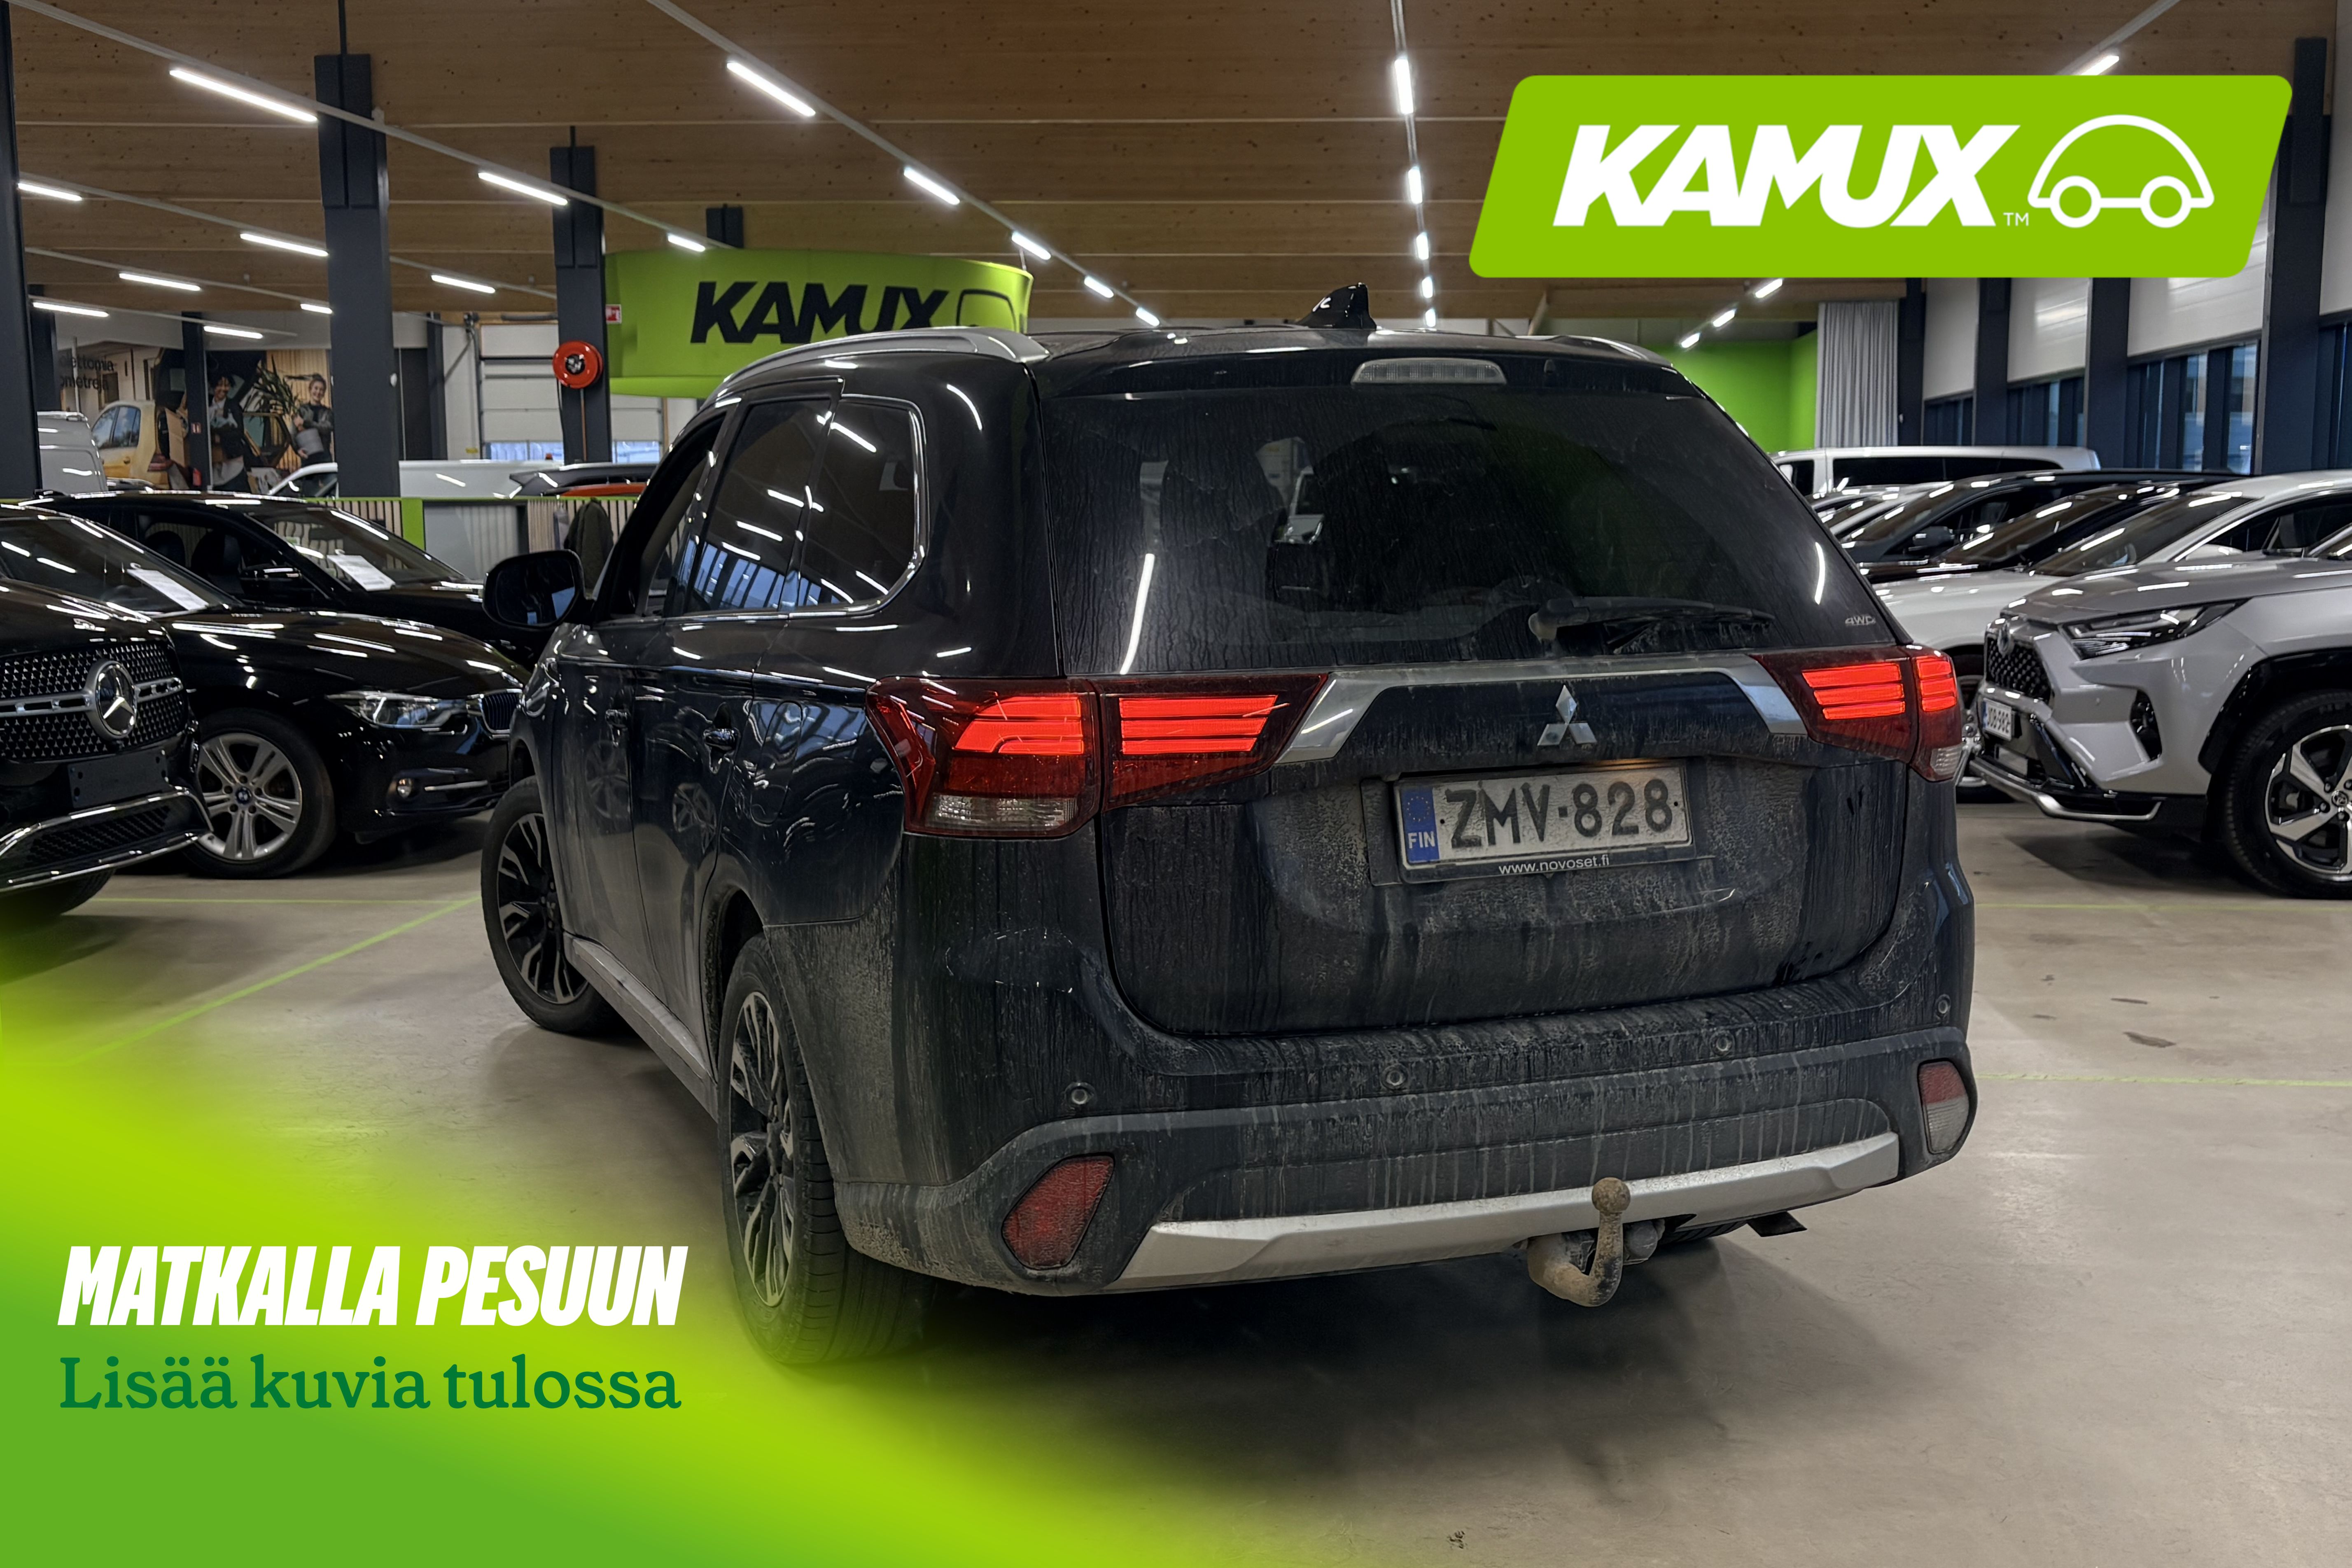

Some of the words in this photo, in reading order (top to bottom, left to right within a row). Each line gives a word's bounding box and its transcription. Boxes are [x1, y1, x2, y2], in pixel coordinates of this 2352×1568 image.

[690, 281, 950, 344] KAMUX
[1443, 779, 1673, 849] ZMV-828
[1408, 831, 1435, 849] FIN
[1498, 854, 1610, 875] www.novoset.fi
